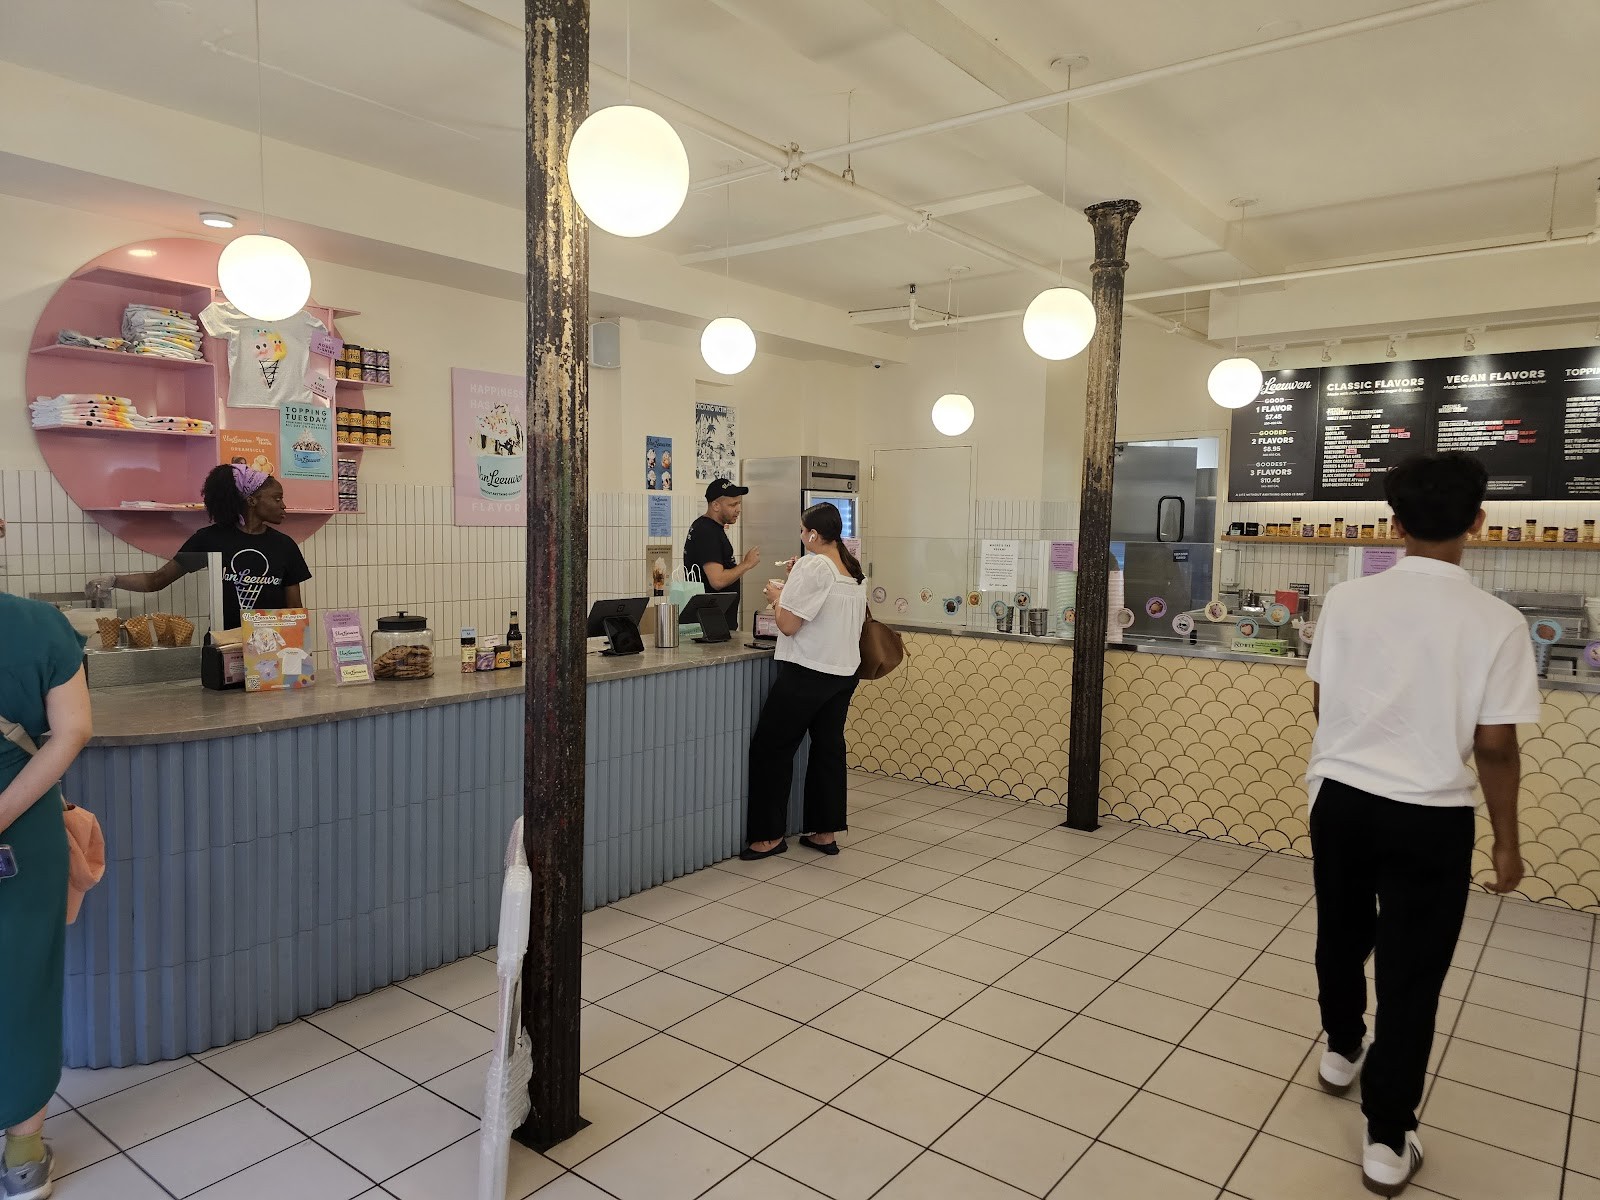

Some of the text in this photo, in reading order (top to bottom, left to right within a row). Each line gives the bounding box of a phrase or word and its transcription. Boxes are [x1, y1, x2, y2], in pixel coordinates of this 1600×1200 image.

[1446, 370, 1545, 384] VEGAN FLAVORS
[471, 383, 524, 398] HAPPINESS
[1260, 377, 1310, 394] Leeuwen
[1327, 378, 1424, 391] CLASSIC FLAVORS
[286, 407, 327, 416] TOPPING
[286, 414, 327, 423] TUESDAY
[234, 569, 282, 586] Leeuwe
